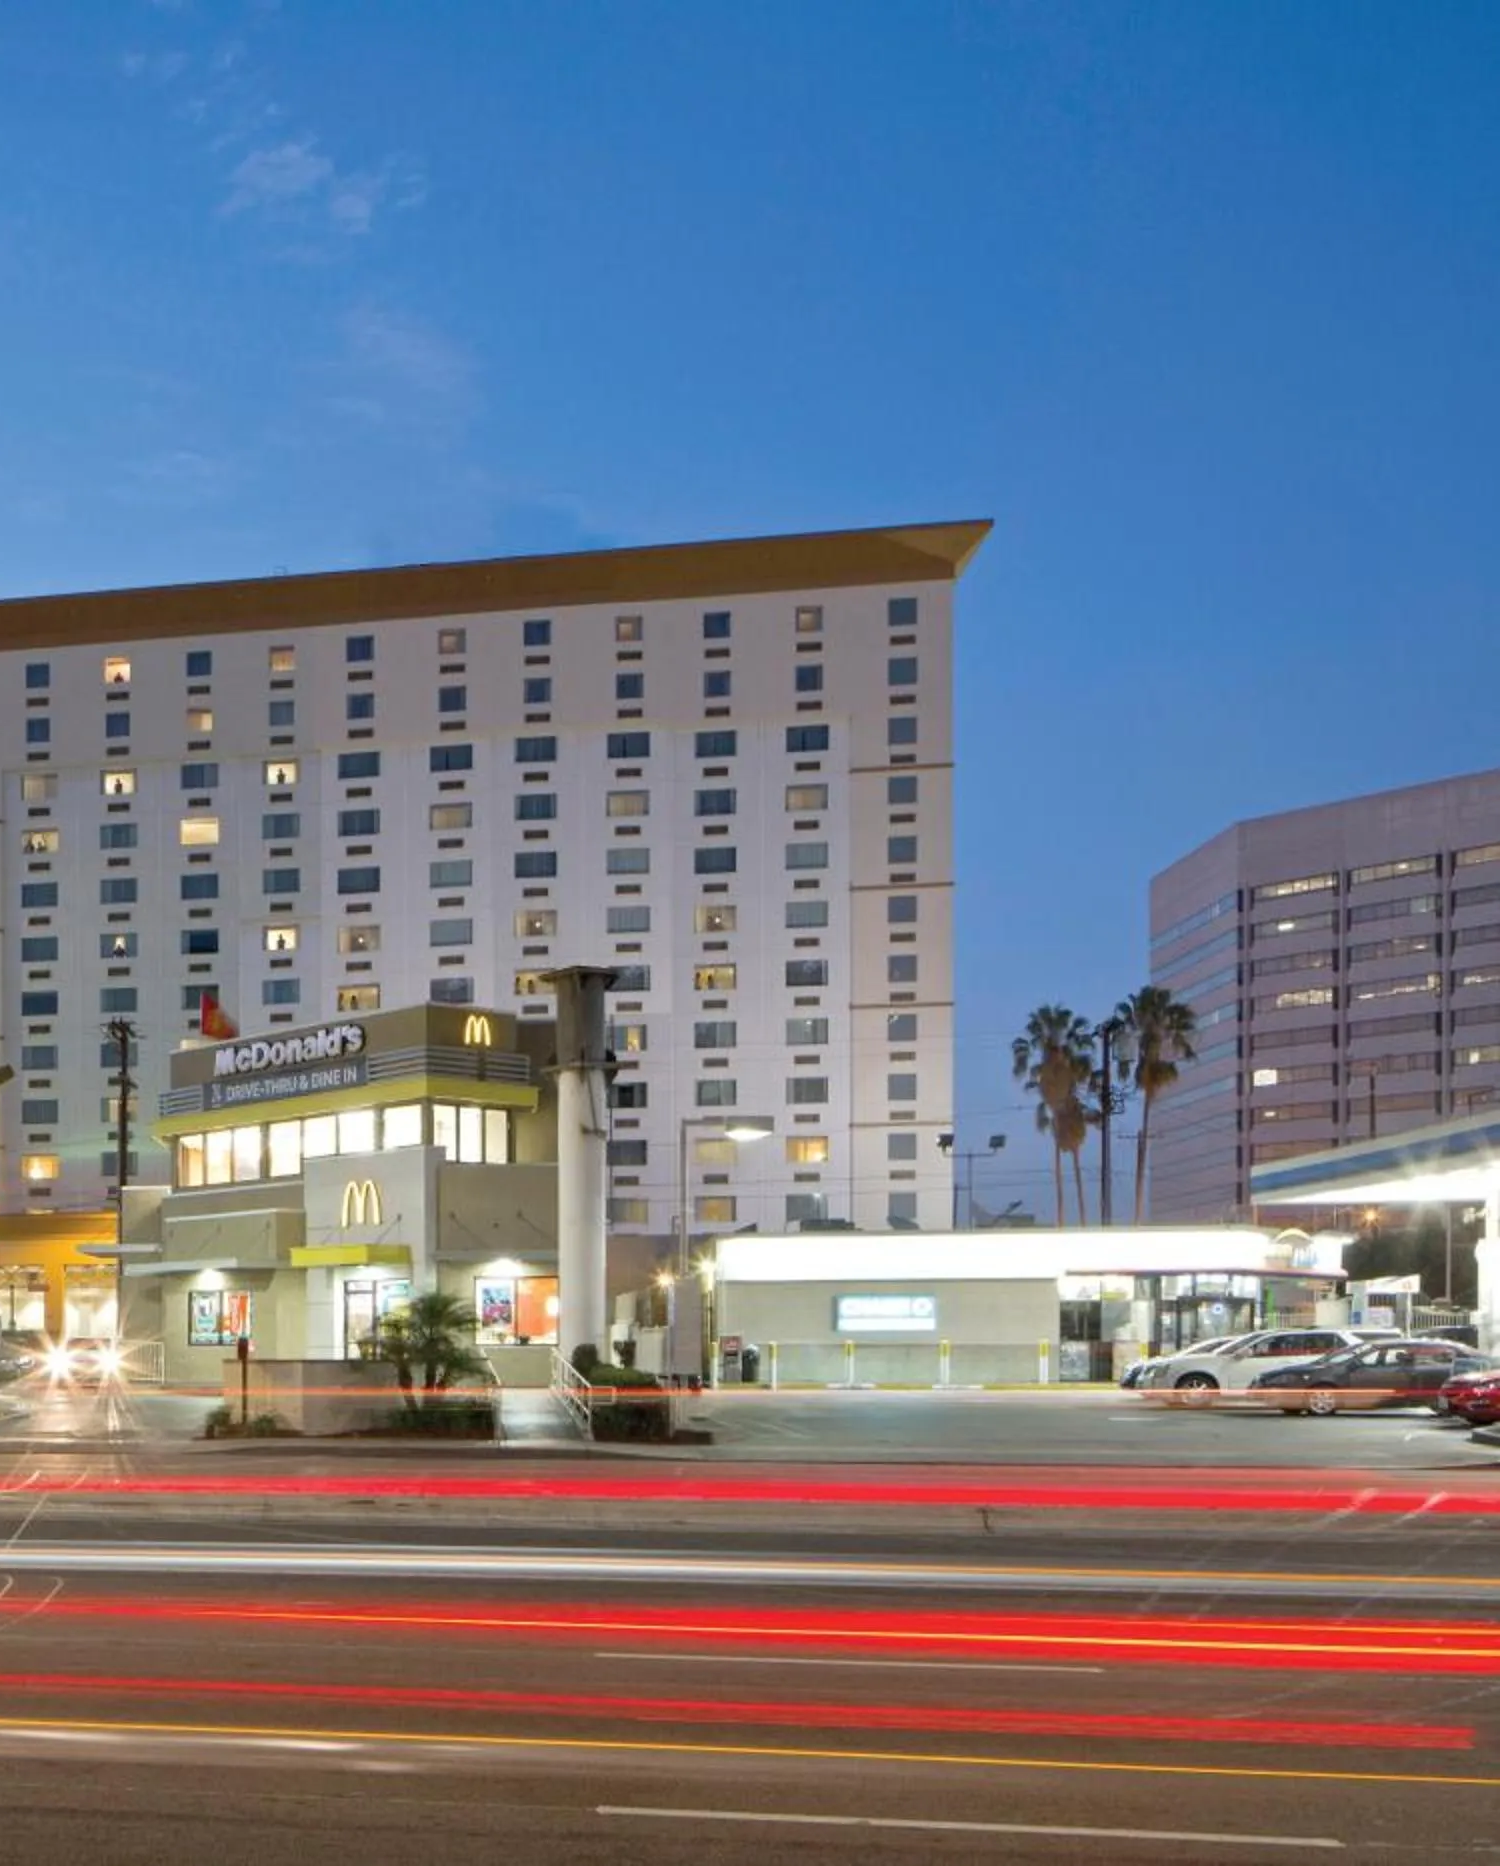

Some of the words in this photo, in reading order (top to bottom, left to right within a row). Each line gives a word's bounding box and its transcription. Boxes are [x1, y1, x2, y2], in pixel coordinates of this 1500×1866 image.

[214, 1024, 366, 1077] McDonald's
[311, 1068, 341, 1089] DINE
[343, 1065, 358, 1084] IN
